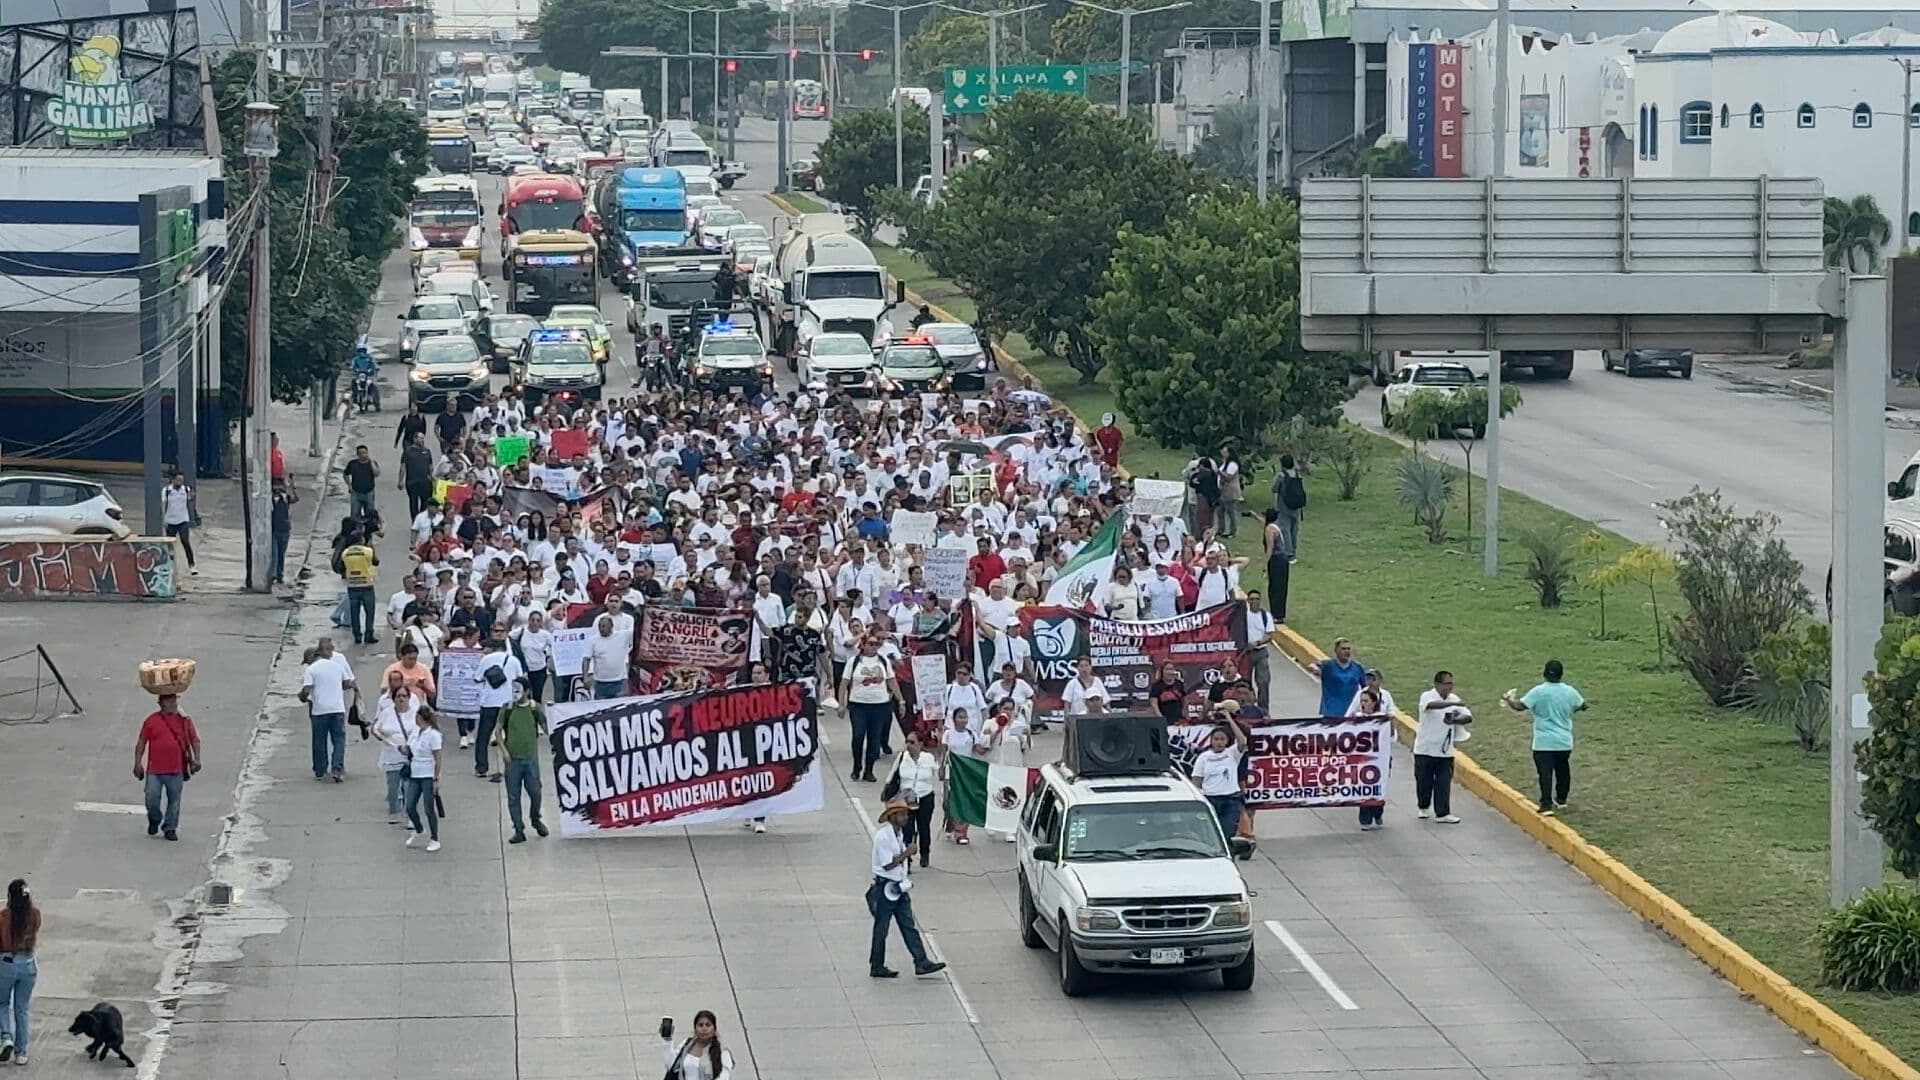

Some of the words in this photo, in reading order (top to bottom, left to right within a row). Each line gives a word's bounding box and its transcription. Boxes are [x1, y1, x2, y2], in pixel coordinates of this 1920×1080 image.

[64, 82, 130, 106] MAMÁ
[1440, 48, 1457, 160] MOTEL
[669, 613, 719, 627] SOLICITA
[1089, 617, 1144, 637] PUEBLO
[1146, 613, 1211, 637] ESCUCHA
[680, 636, 717, 647] ZAPATA
[1034, 660, 1081, 683] MSS
[563, 718, 613, 762] CON
[619, 708, 664, 751] MIS
[668, 704, 685, 740] 2
[691, 684, 802, 732] NEURONAS
[558, 735, 709, 810] SALVAMOS
[716, 730, 749, 772] AL
[755, 711, 812, 764] PAÍS
[1271, 757, 1289, 769] LO
[1291, 756, 1318, 769] QUE
[1321, 755, 1347, 767] POR
[1245, 764, 1382, 789] DERECHO
[610, 802, 628, 822] EN
[632, 798, 650, 819] LA
[653, 780, 729, 816] PANDEMIA
[731, 770, 775, 797] COVID
